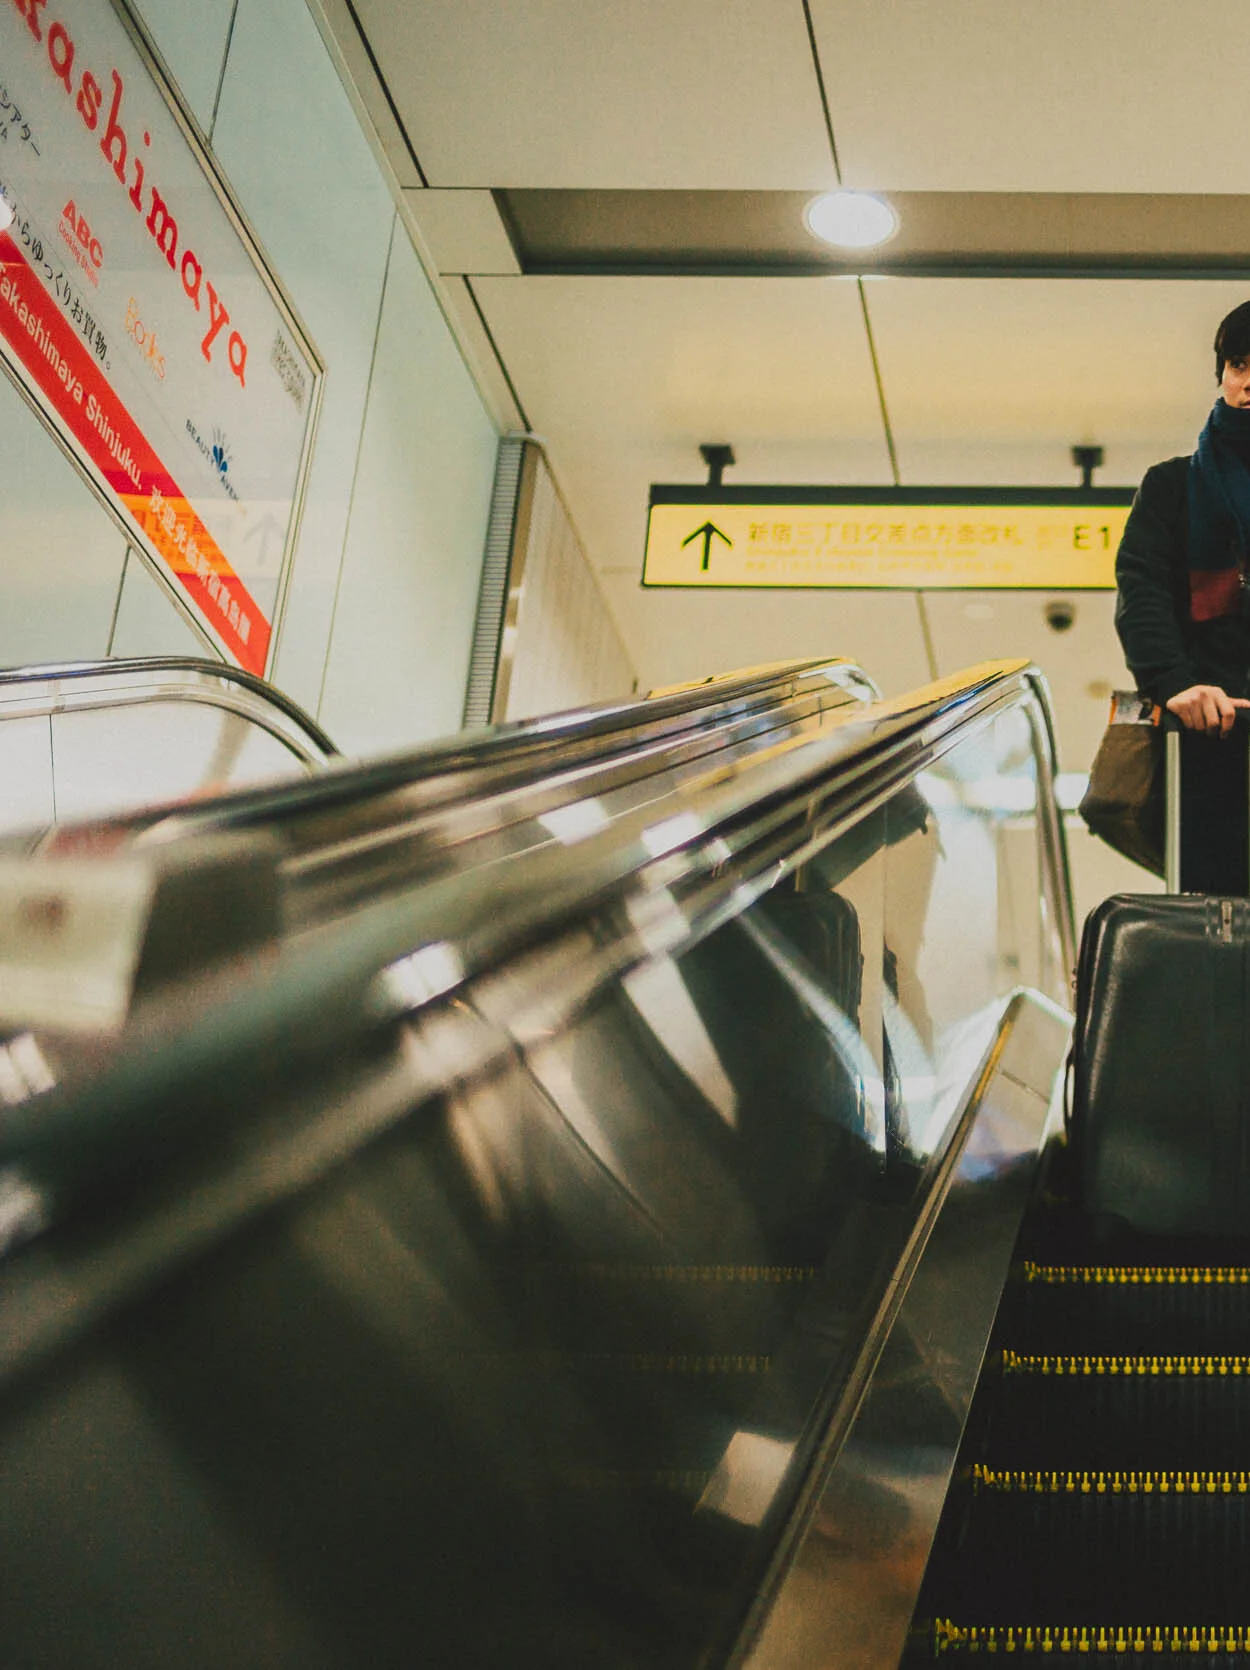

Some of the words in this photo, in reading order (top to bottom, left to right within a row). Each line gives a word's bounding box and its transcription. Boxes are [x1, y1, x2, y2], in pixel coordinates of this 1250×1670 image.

[62, 200, 104, 268] ABC
[86, 394, 142, 490] Shinjuku.
[1073, 523, 1110, 550] E1
